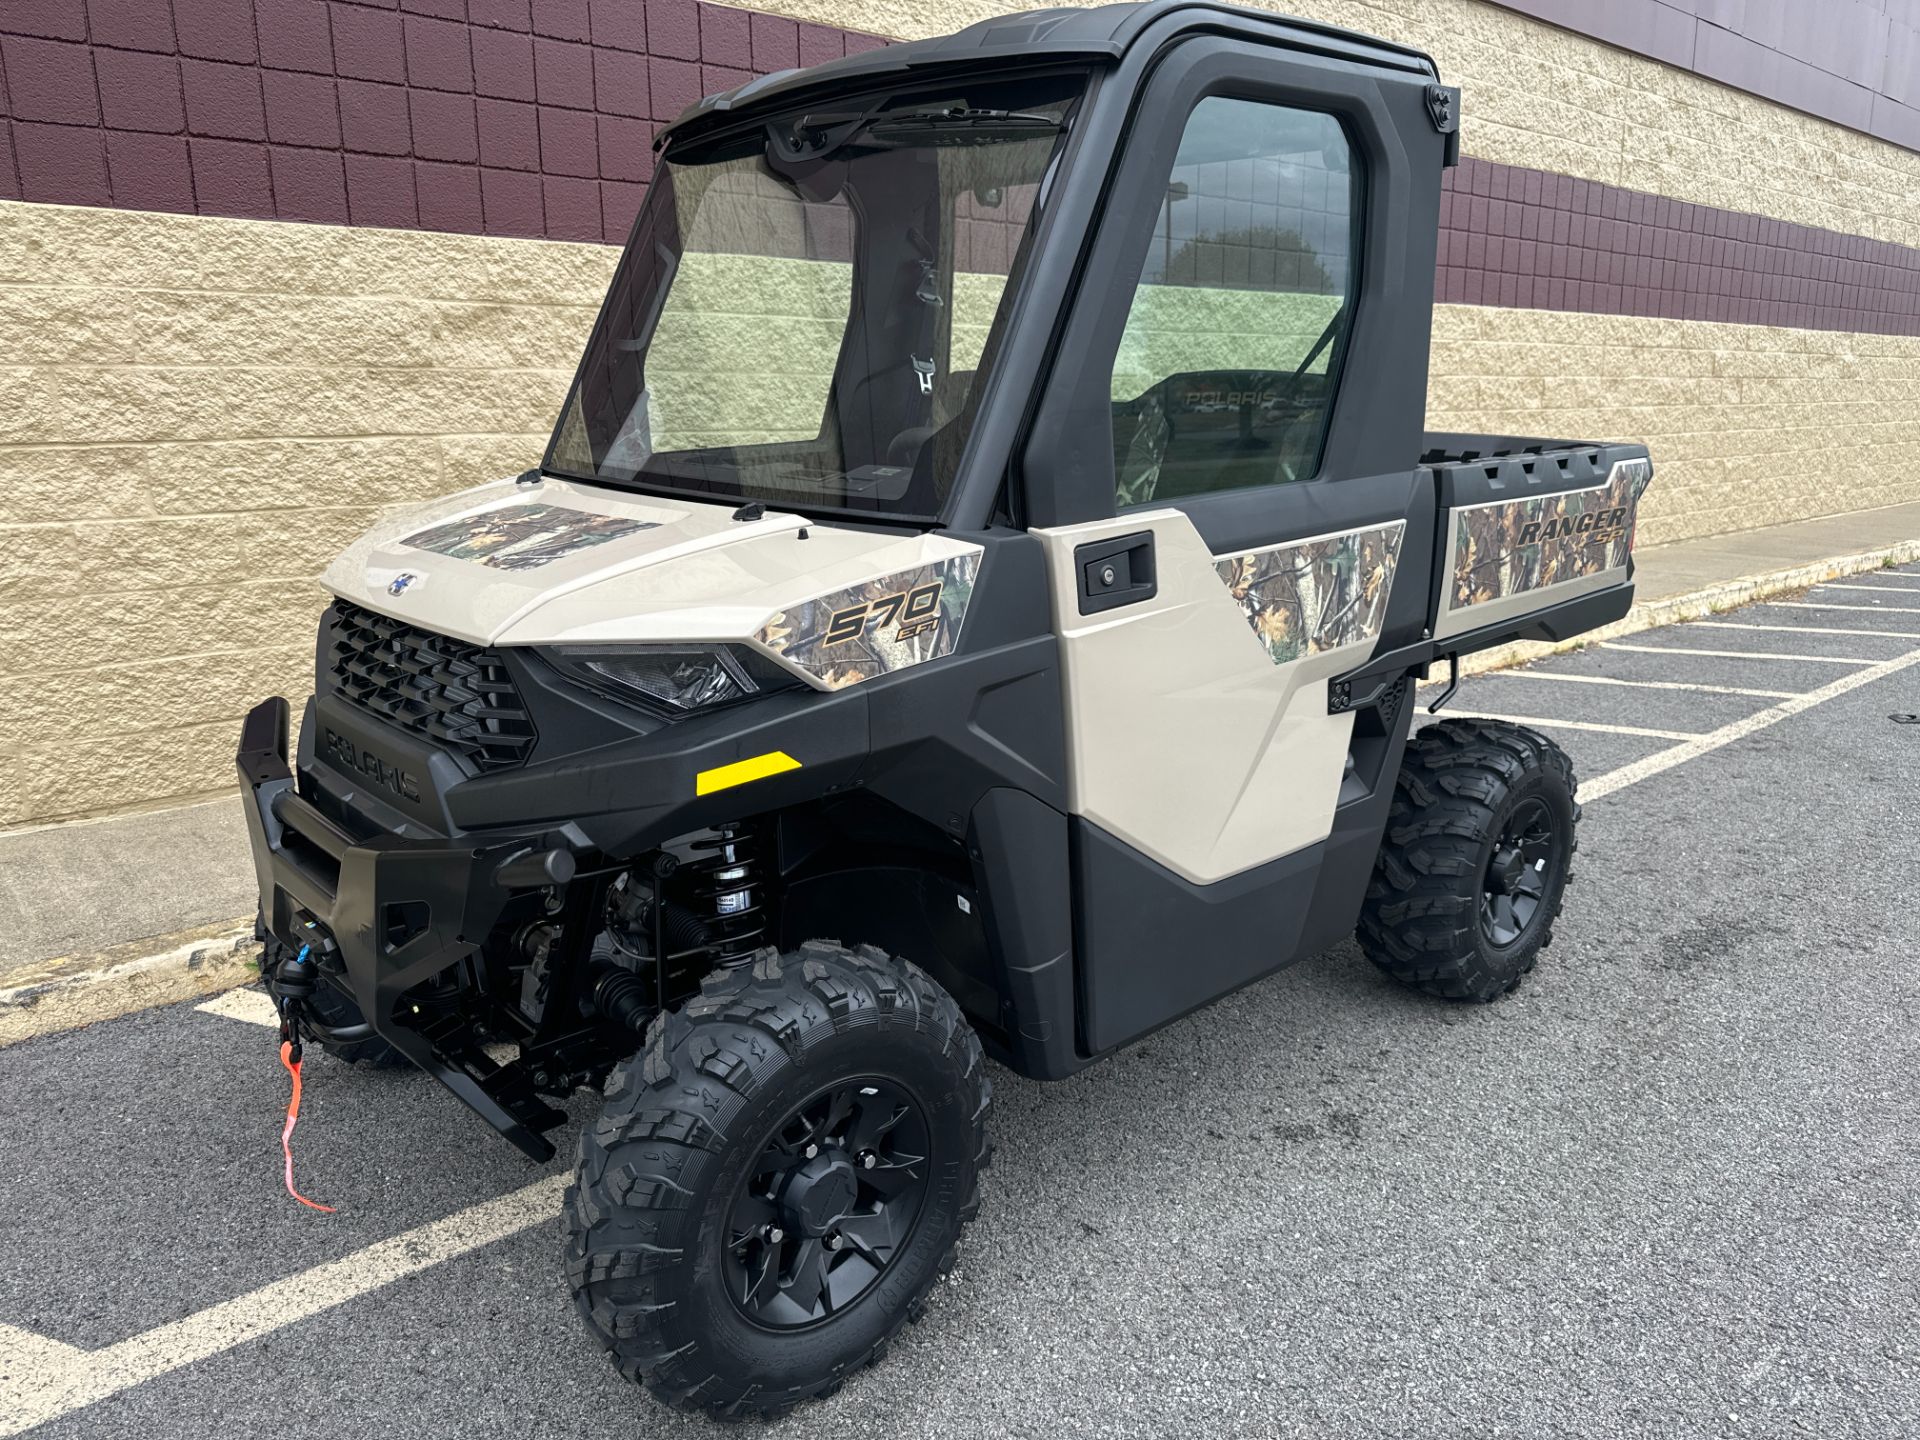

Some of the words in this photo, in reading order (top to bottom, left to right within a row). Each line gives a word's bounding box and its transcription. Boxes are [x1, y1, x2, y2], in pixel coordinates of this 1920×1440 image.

[1185, 391, 1277, 404] POLARIS
[1515, 506, 1627, 548] RANGER
[1592, 527, 1625, 546] SP
[822, 581, 944, 648] 570
[894, 617, 941, 643] EFI
[325, 727, 422, 804] POLARIS
